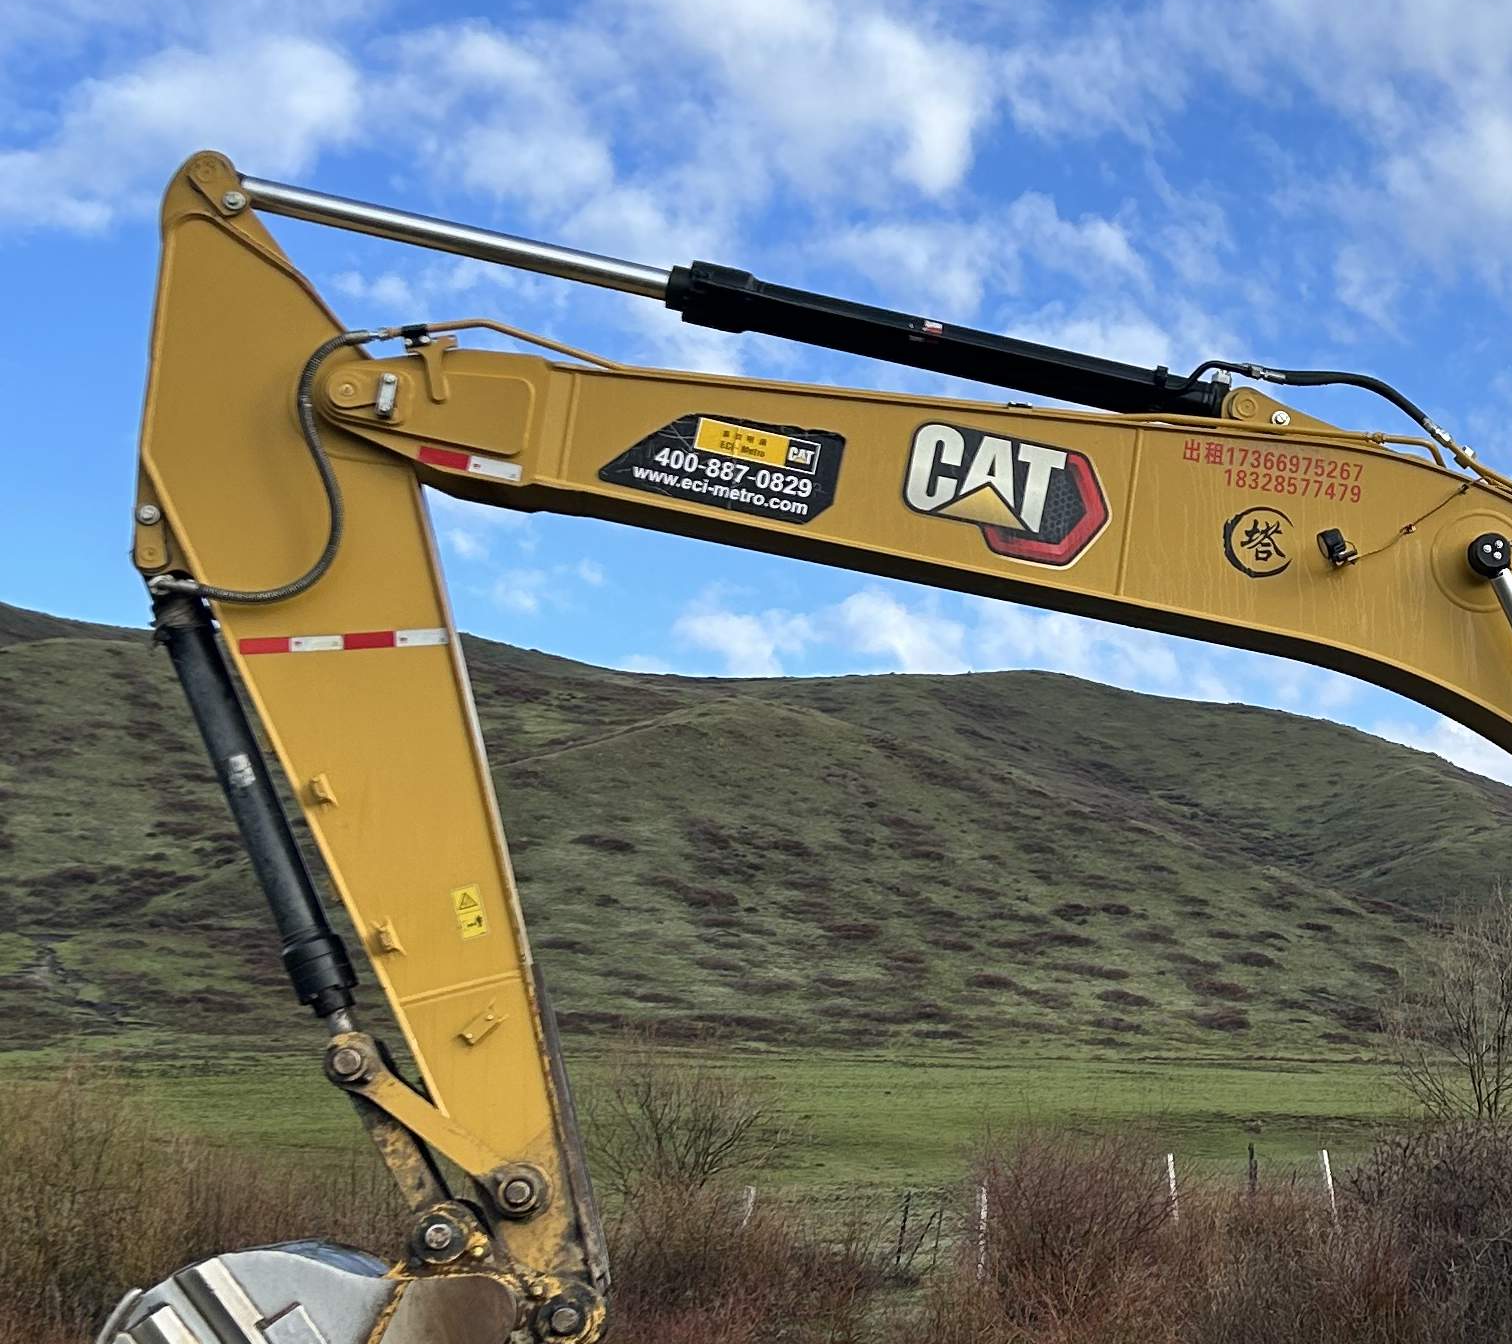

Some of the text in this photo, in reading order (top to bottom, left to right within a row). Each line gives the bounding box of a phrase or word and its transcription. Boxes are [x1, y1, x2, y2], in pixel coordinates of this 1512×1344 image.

[654, 447, 813, 498] 400-887-0829
[787, 446, 815, 465] CAT
[907, 424, 1069, 533] CAT
[1183, 438, 1364, 482] 出租17366975267
[632, 465, 809, 516] www.eci-metro.com
[1223, 469, 1362, 504] 18328577479
